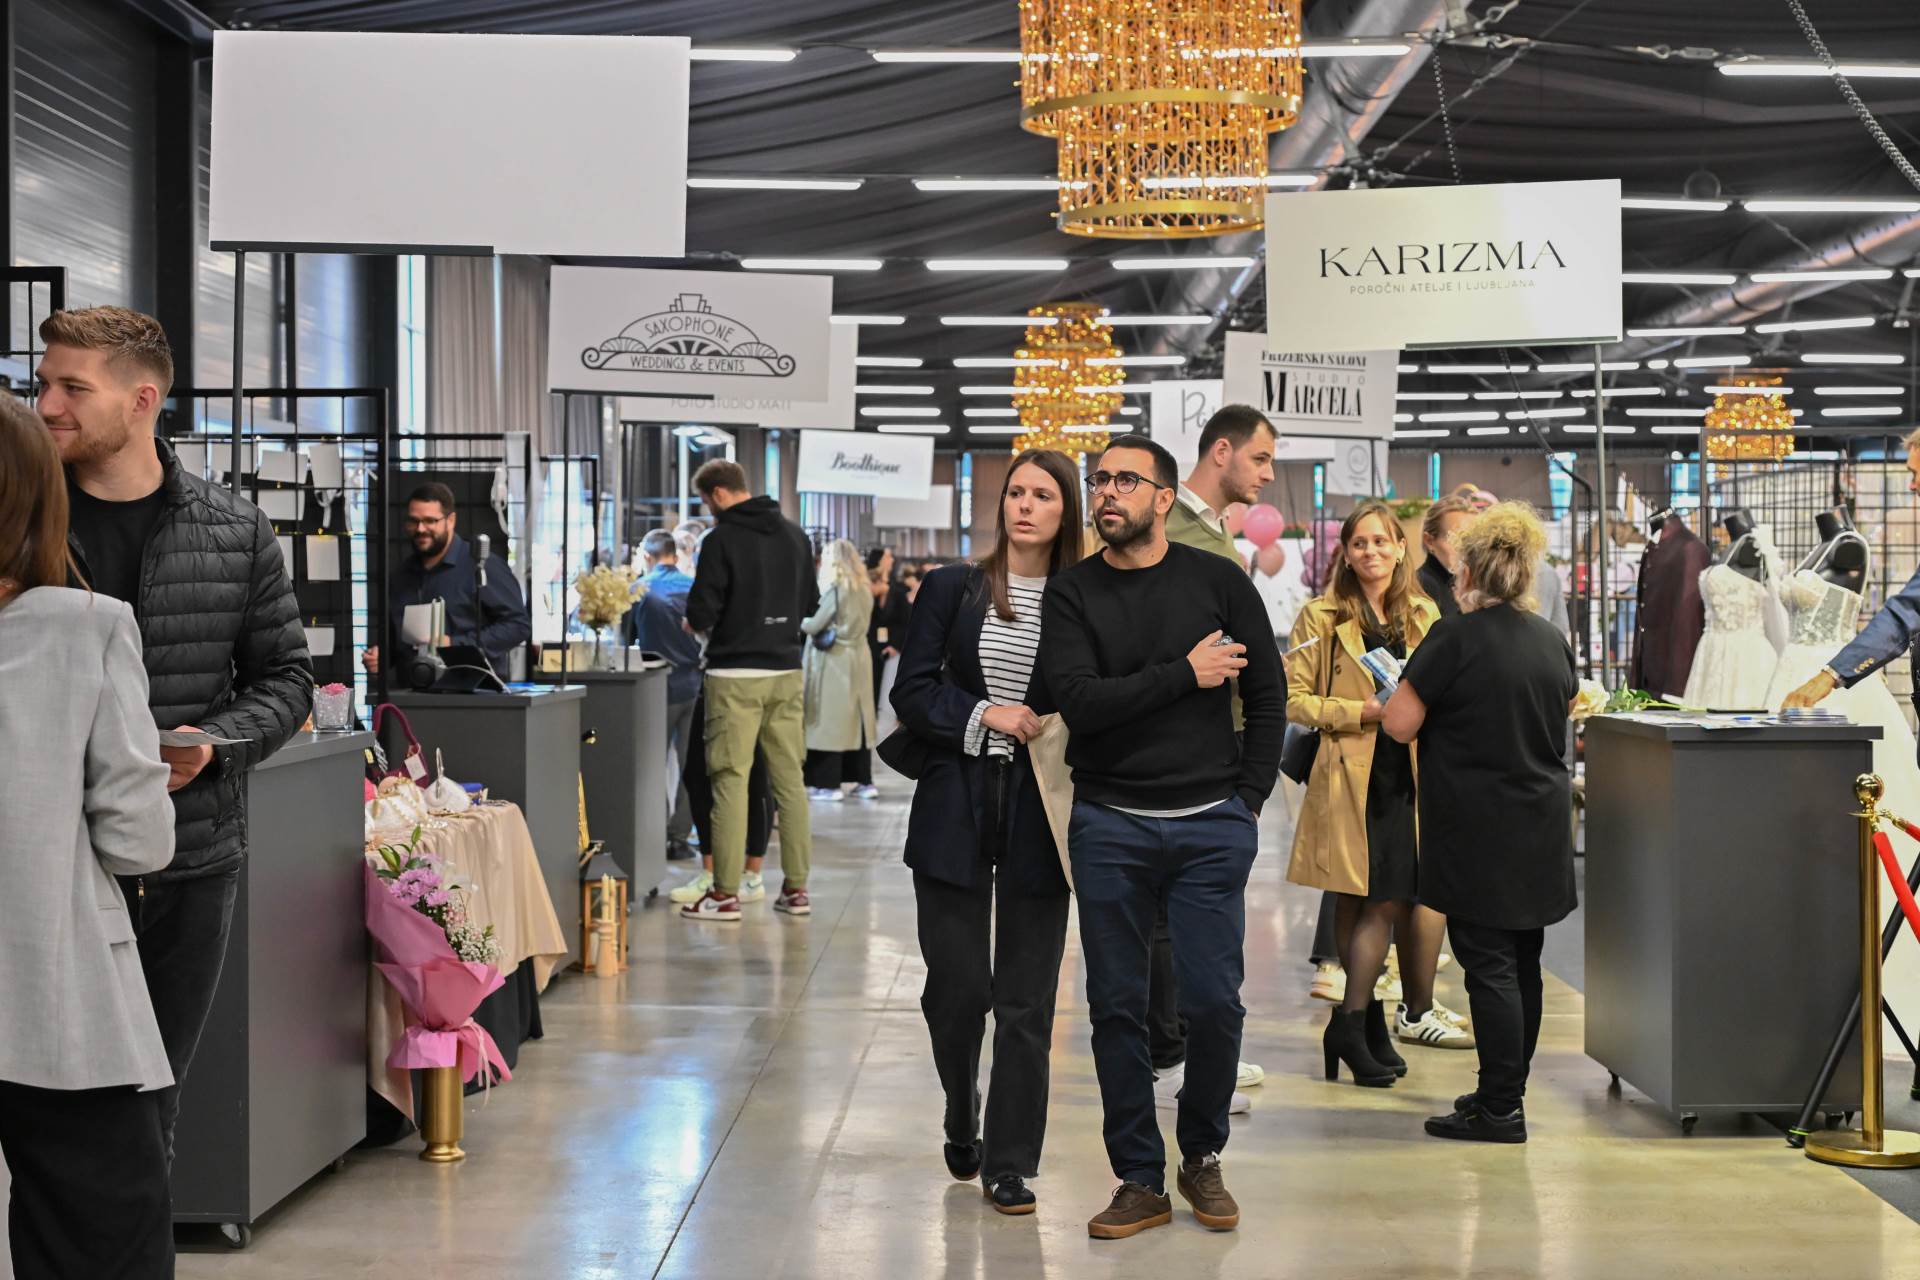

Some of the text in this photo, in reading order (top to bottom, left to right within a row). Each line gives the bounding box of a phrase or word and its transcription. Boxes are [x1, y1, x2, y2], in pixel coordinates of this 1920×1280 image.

[1320, 239, 1567, 278] KARIZMA
[1350, 281, 1405, 295] POROČNI
[1410, 281, 1452, 293] ATELJE
[1466, 279, 1535, 290] LJUBLJANA
[644, 316, 735, 343] SAXOPHONE
[631, 356, 745, 372] WEDDINGS & EVENTS
[1293, 372, 1366, 385] STUDIO
[1261, 371, 1363, 417] MARCELA
